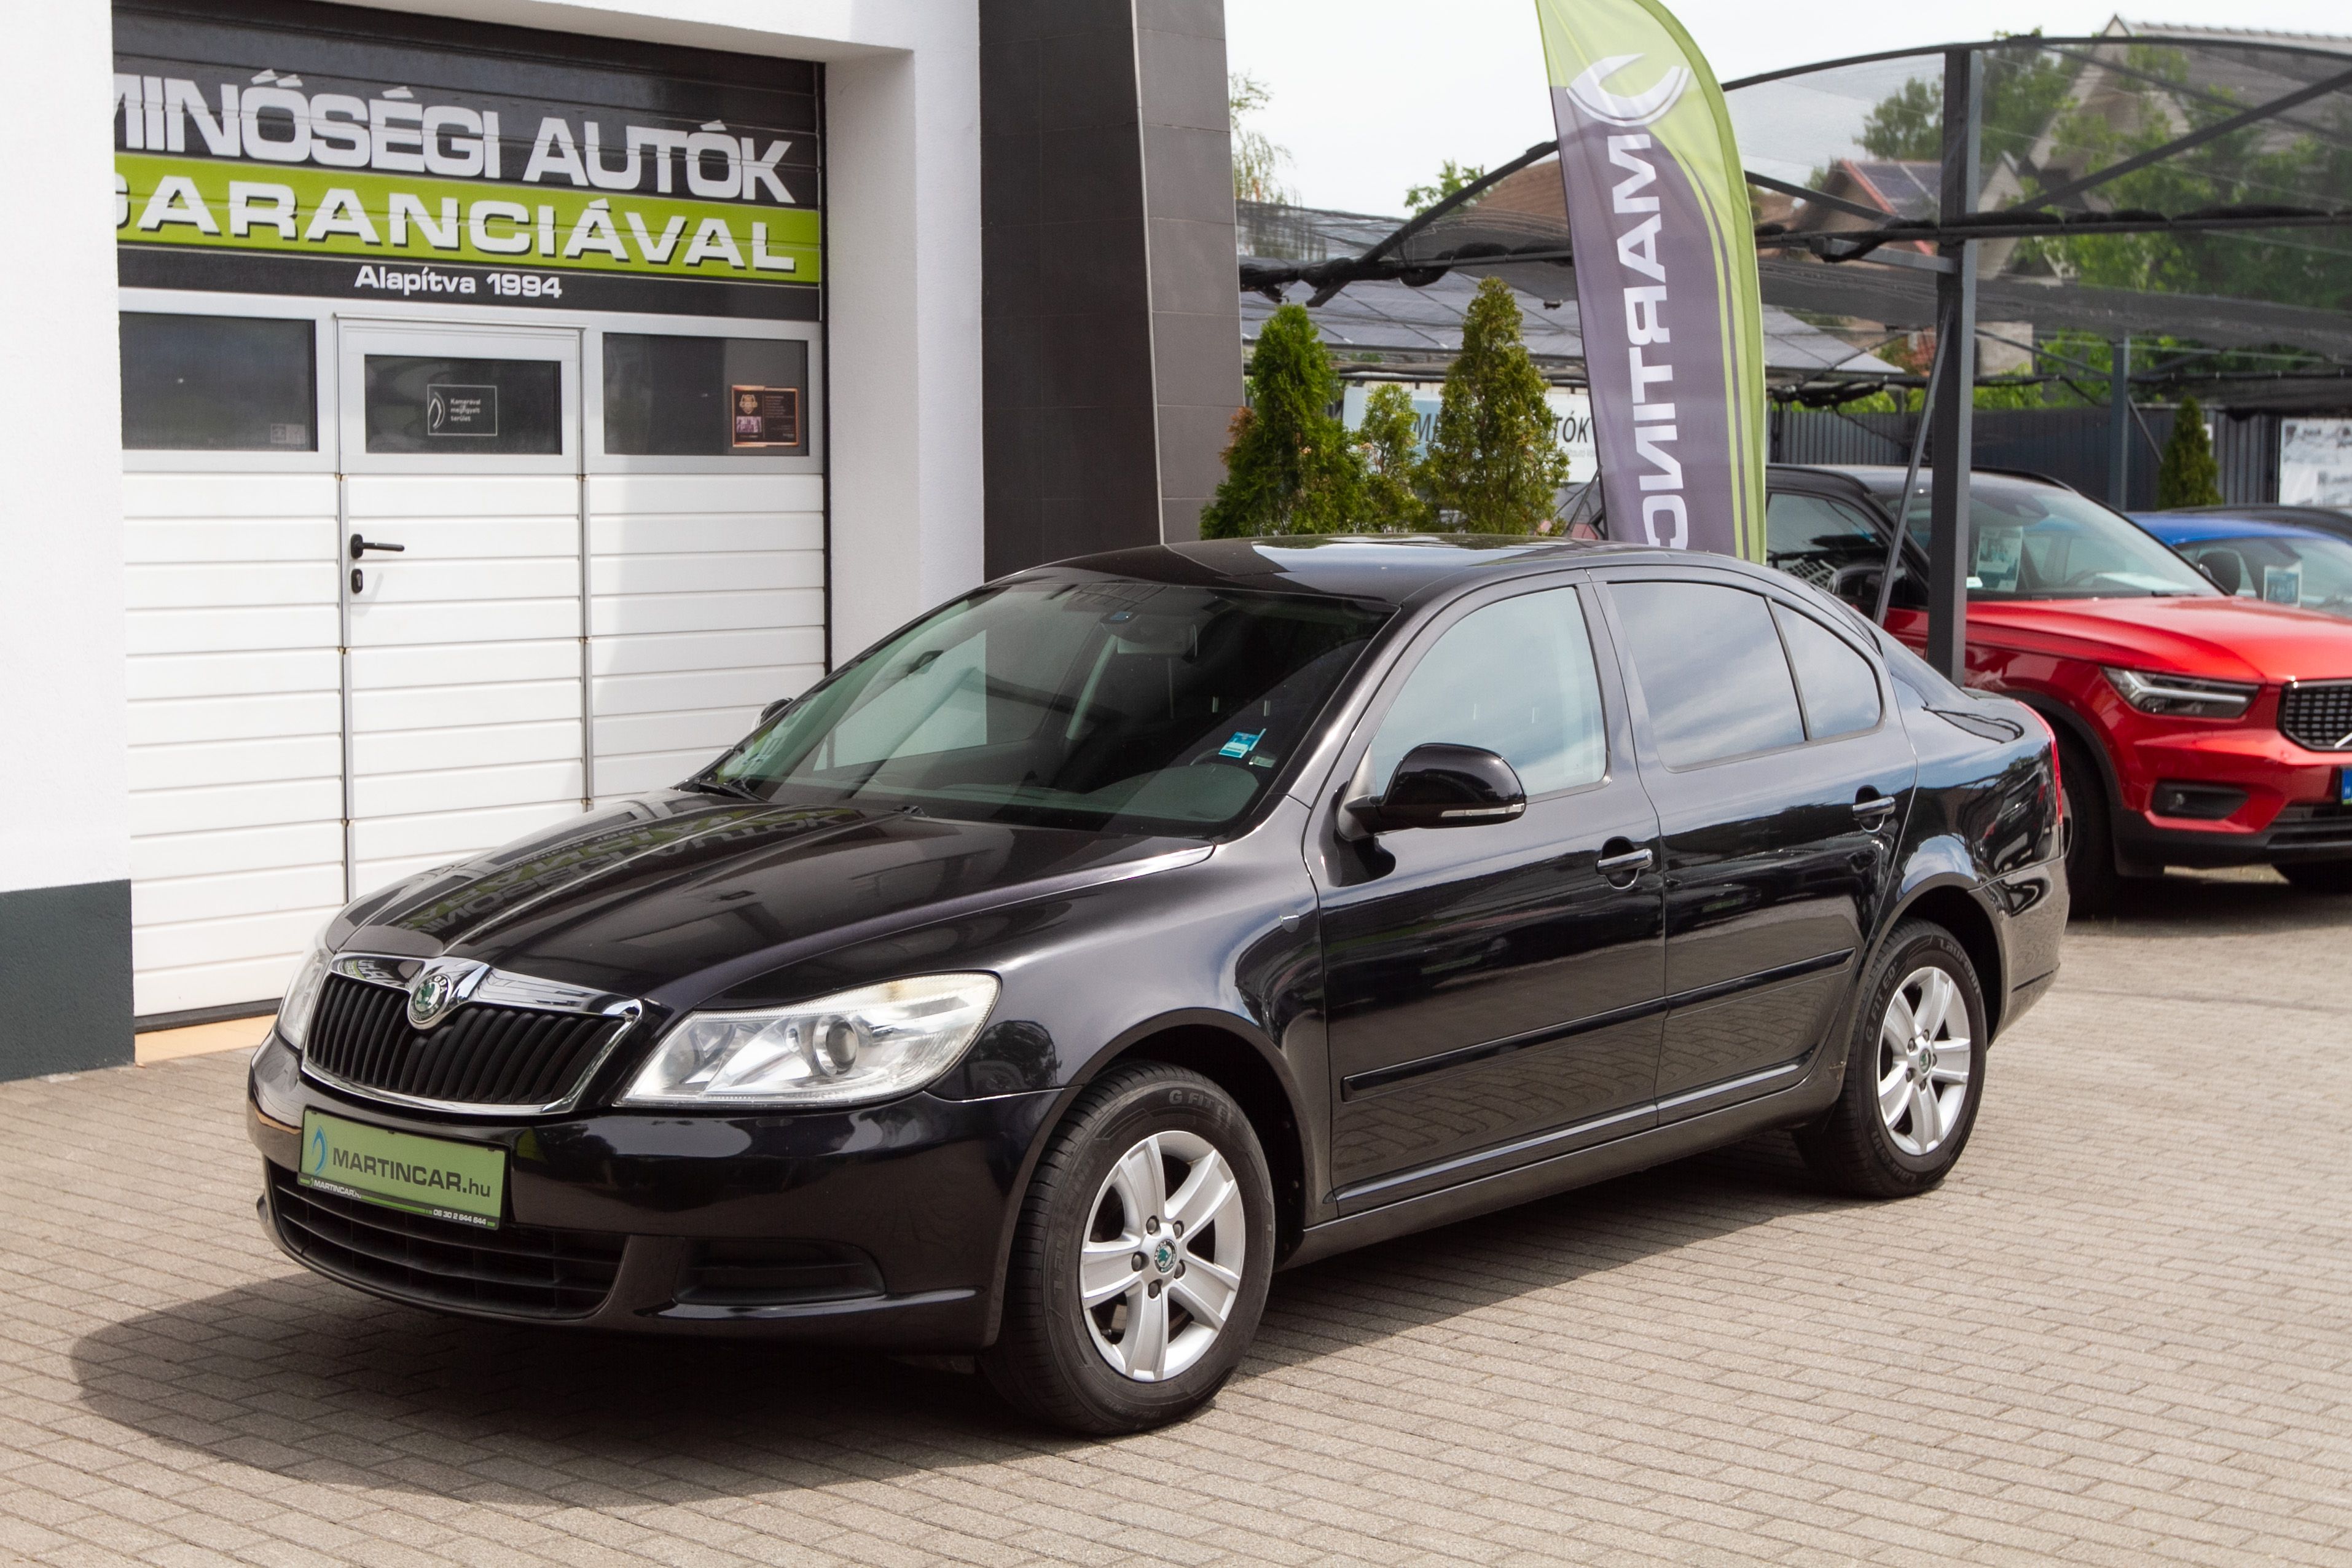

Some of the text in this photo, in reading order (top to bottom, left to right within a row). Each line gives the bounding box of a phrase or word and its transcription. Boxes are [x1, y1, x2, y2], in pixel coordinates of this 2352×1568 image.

[522, 117, 796, 203] AUTÓK
[115, 173, 795, 272] ARANCIÁVAL
[354, 265, 563, 299] Alapítva 1994
[1169, 1089, 1215, 1108] G FIT
[332, 1147, 490, 1198] MARTINCAR.hu
